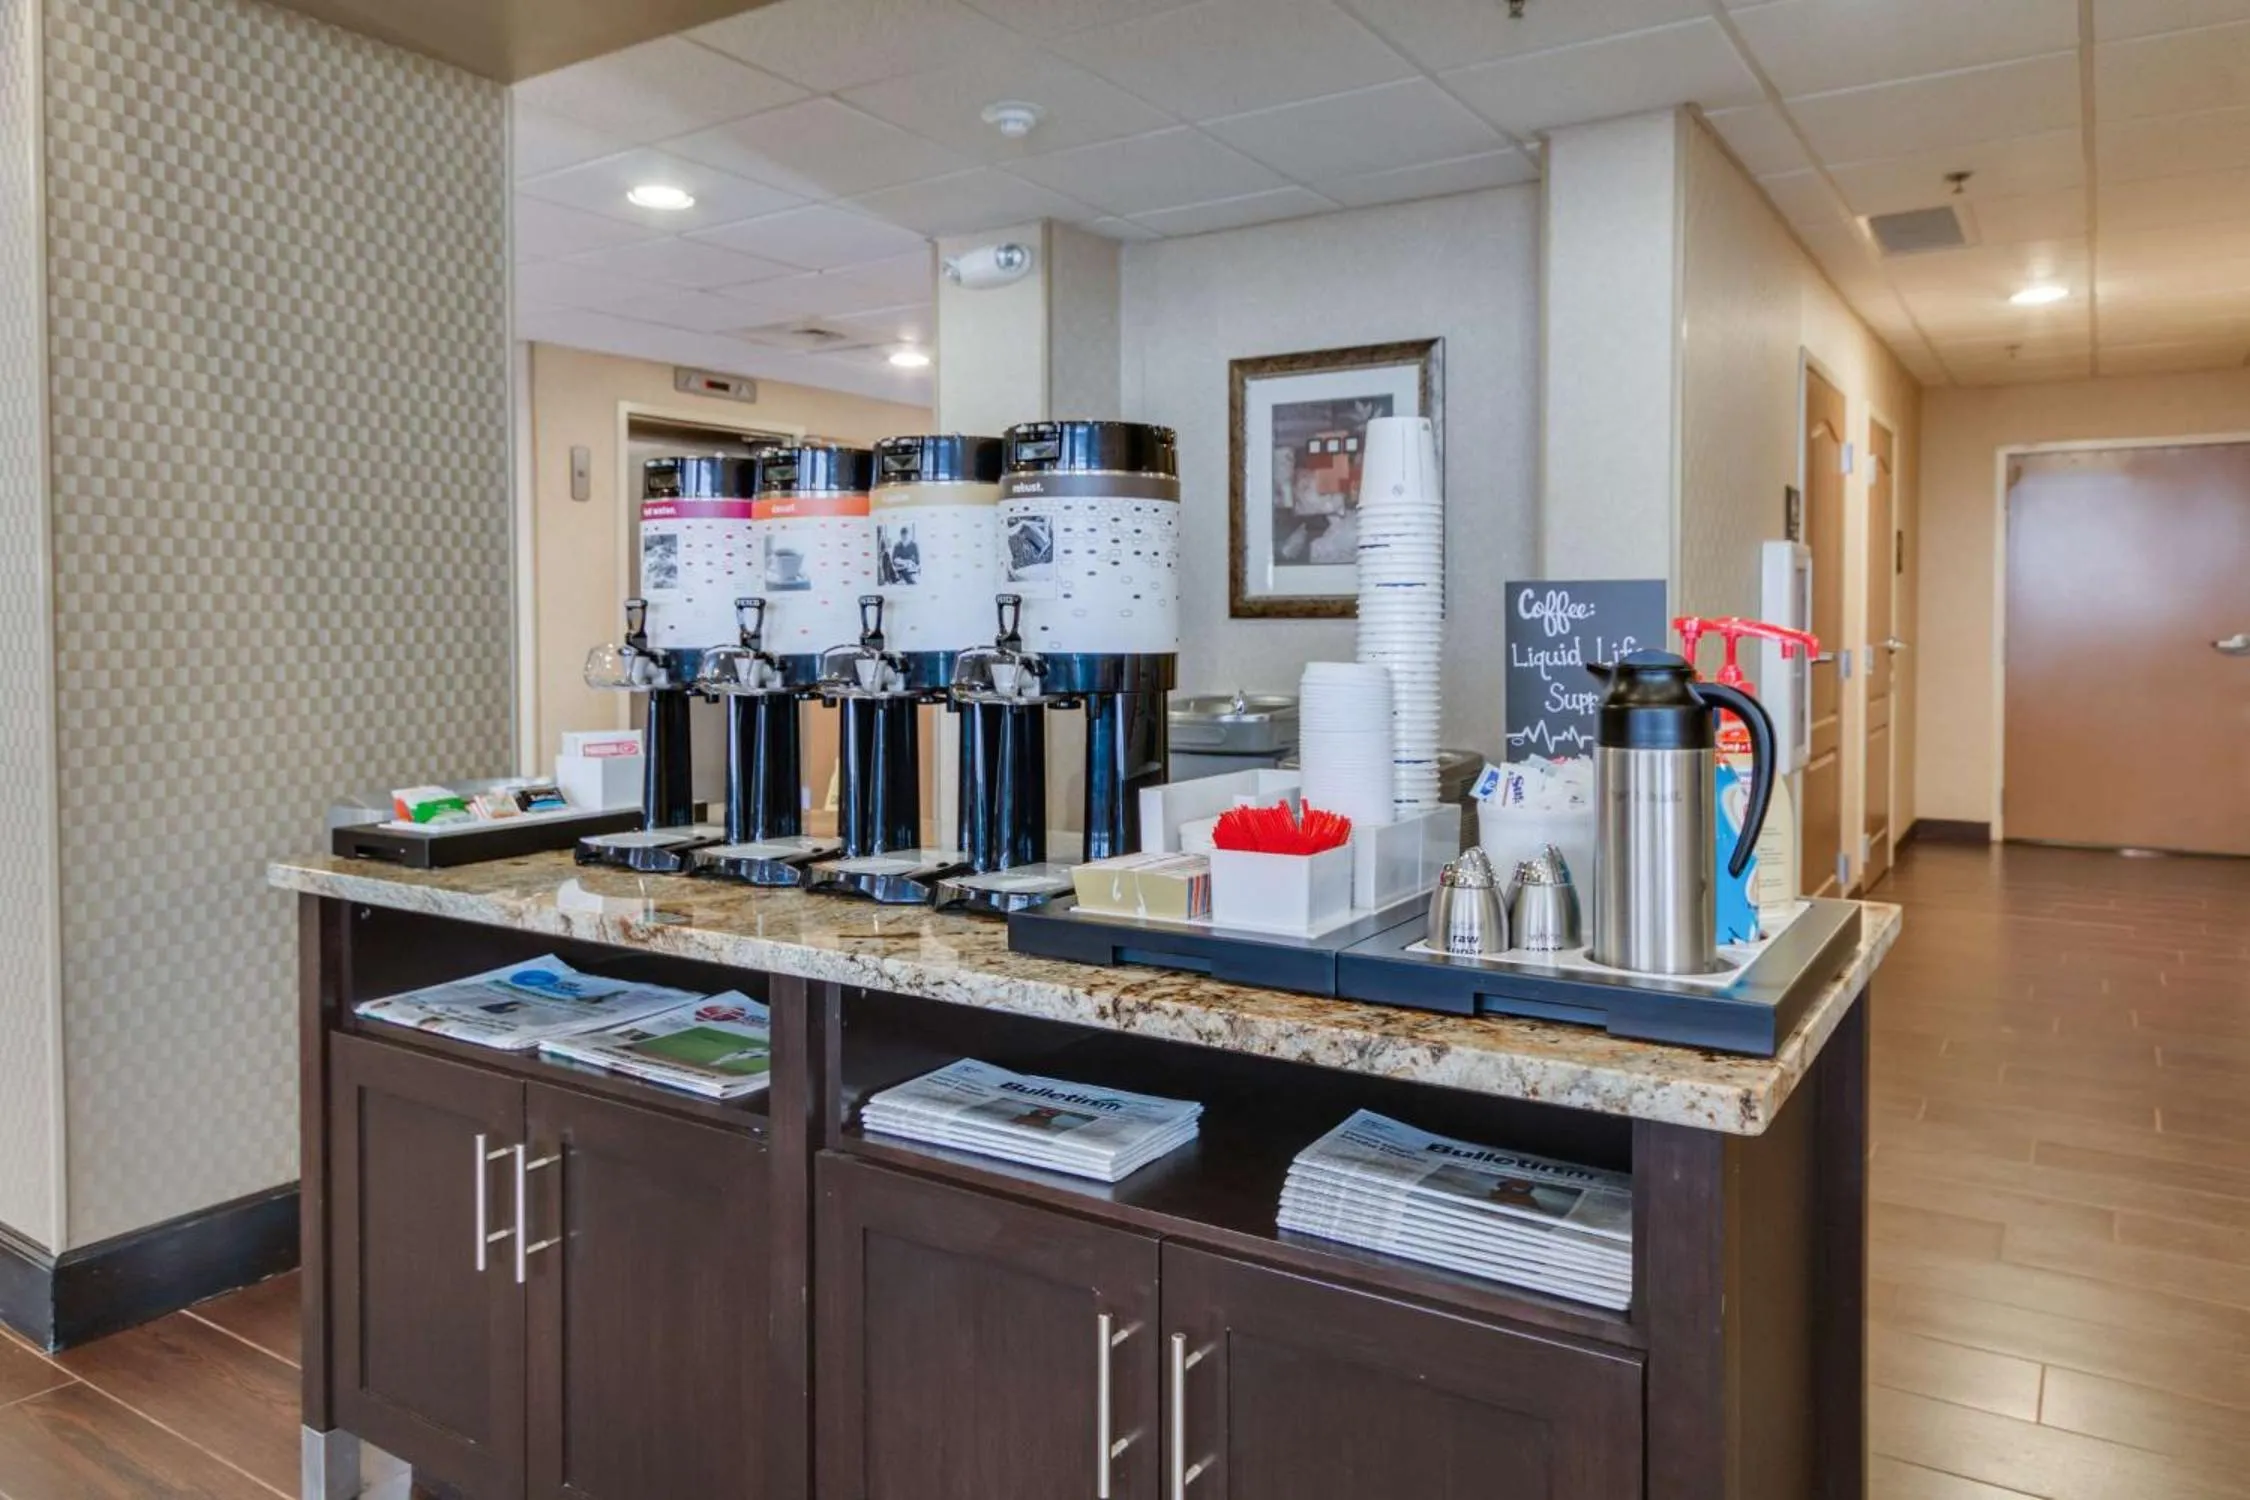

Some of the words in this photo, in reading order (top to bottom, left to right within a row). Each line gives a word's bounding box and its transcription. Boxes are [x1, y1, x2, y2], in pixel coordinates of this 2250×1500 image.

[1518, 588, 1595, 637] Coffee:
[1511, 636, 1583, 681] Liquid
[1597, 636, 1643, 666] Lif
[1452, 935, 1479, 944] raw
